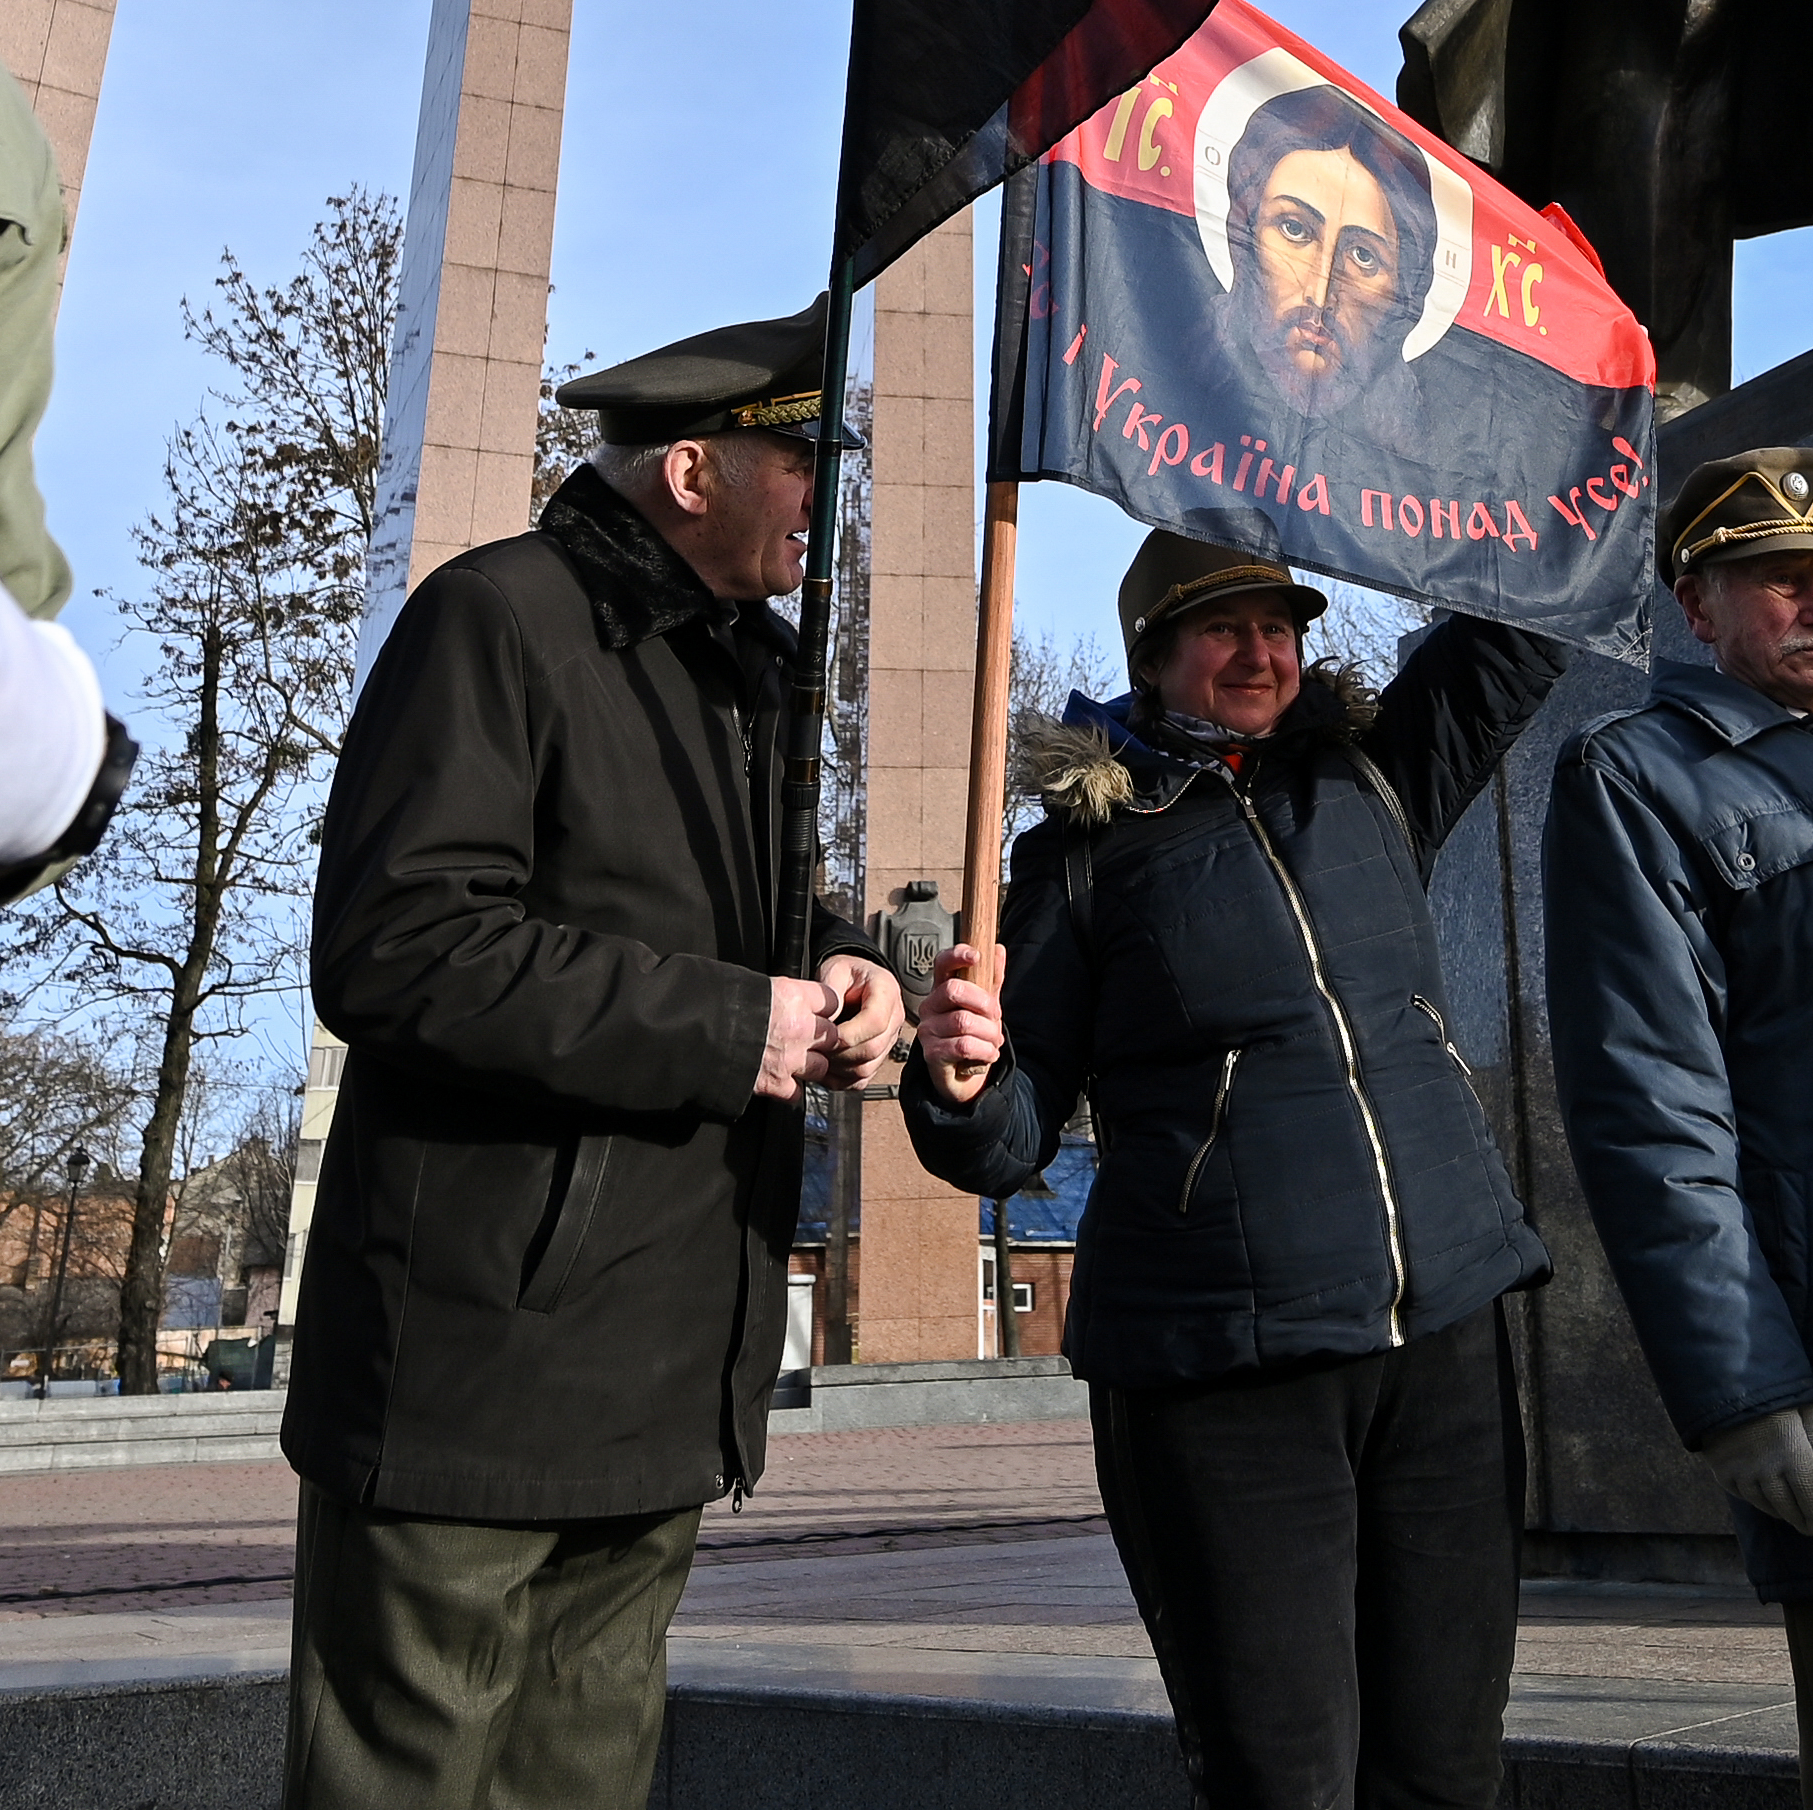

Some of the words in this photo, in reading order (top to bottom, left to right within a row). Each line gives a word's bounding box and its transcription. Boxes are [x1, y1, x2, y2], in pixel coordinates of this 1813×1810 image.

[1093, 352, 1331, 516] Україна
[1360, 488, 1538, 553] понад
[1547, 436, 1650, 541] усе!
